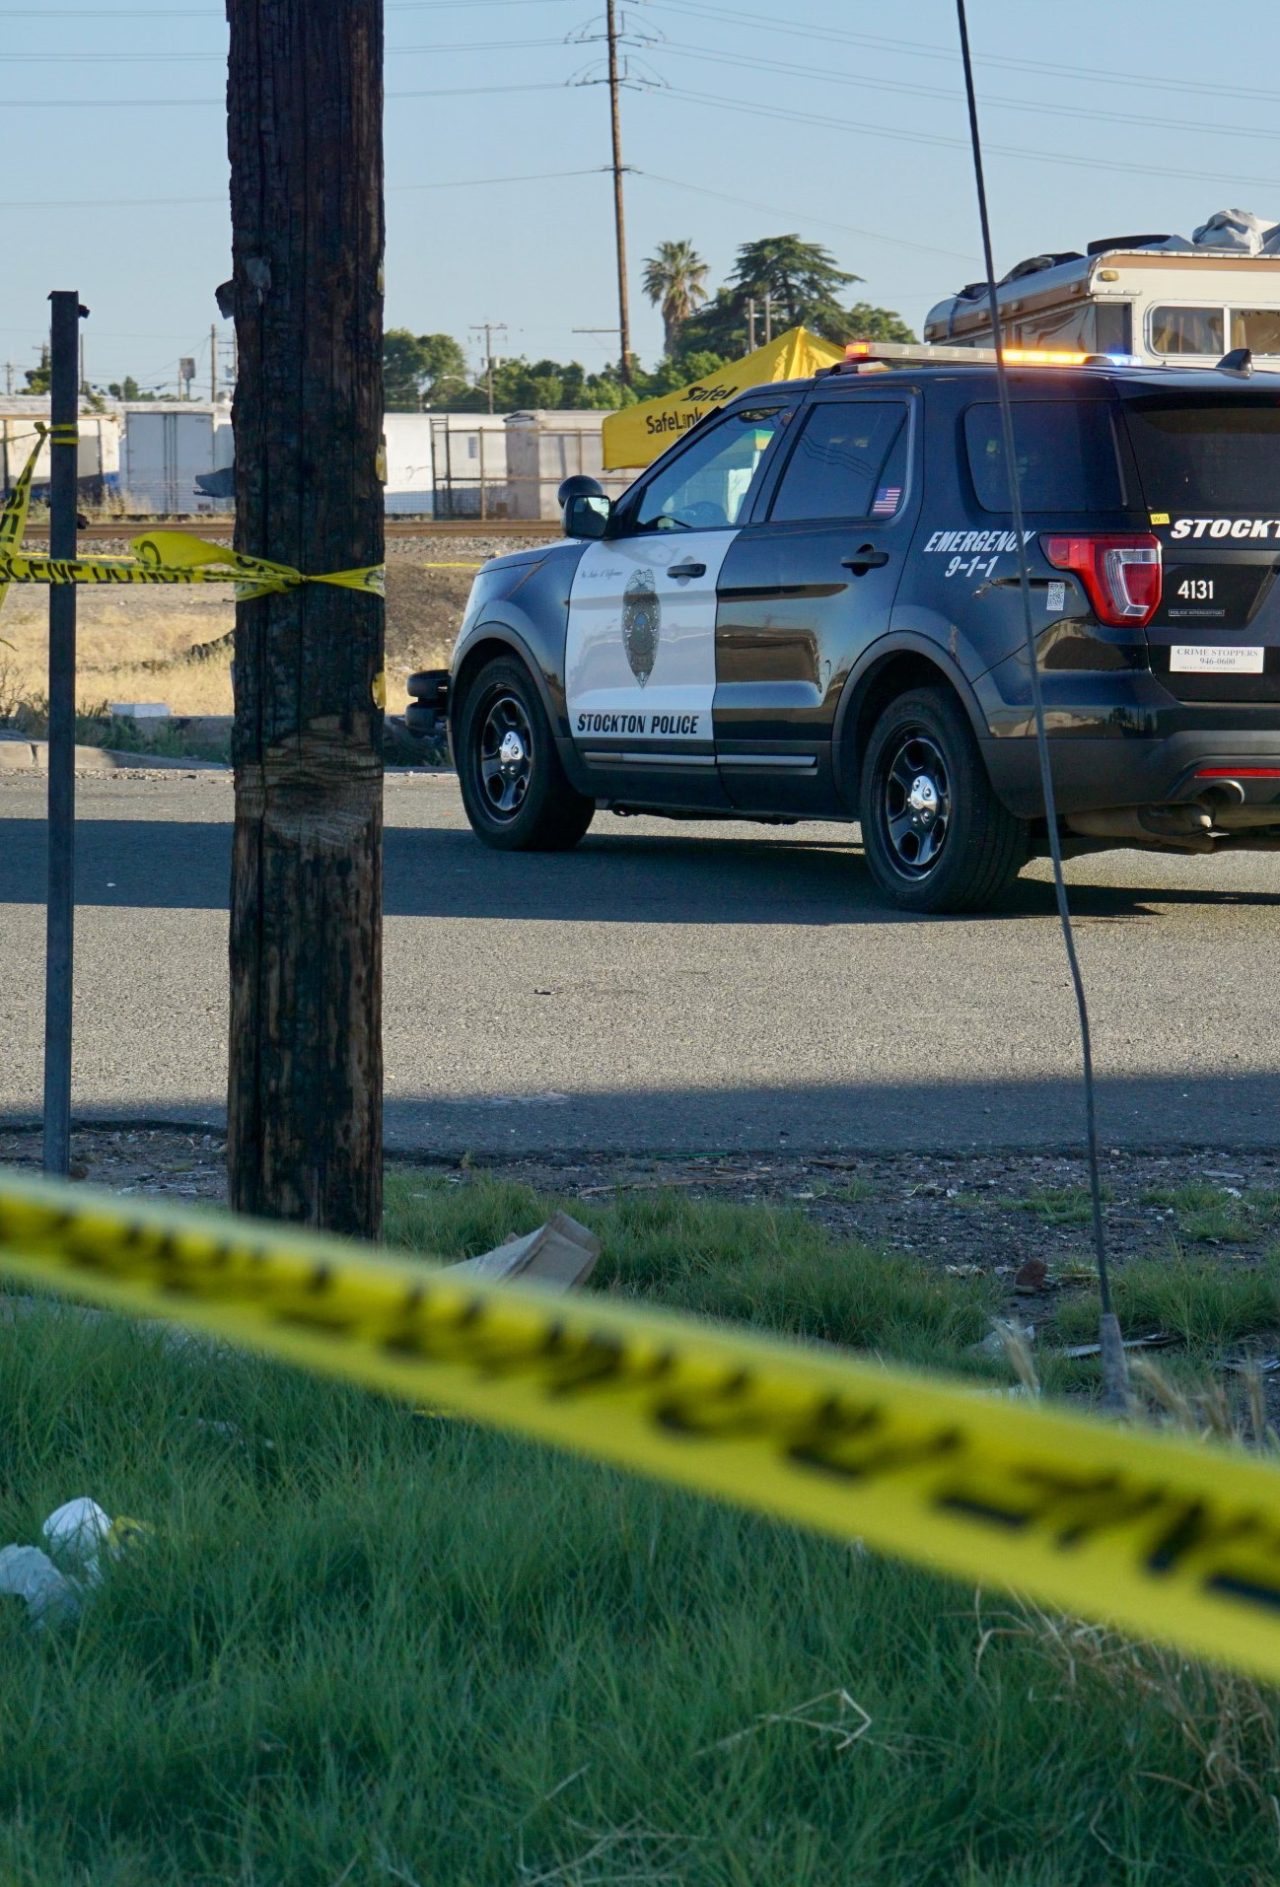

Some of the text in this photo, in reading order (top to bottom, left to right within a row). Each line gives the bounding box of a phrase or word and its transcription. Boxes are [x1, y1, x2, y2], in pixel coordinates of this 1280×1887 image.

[923, 530, 1037, 553] EMERGENCY
[944, 555, 1000, 578] 9-1-1
[1177, 579, 1214, 600] 4131
[1176, 648, 1259, 657] CRIME STOPPERS
[577, 713, 700, 735] STOCKTON POLICE
